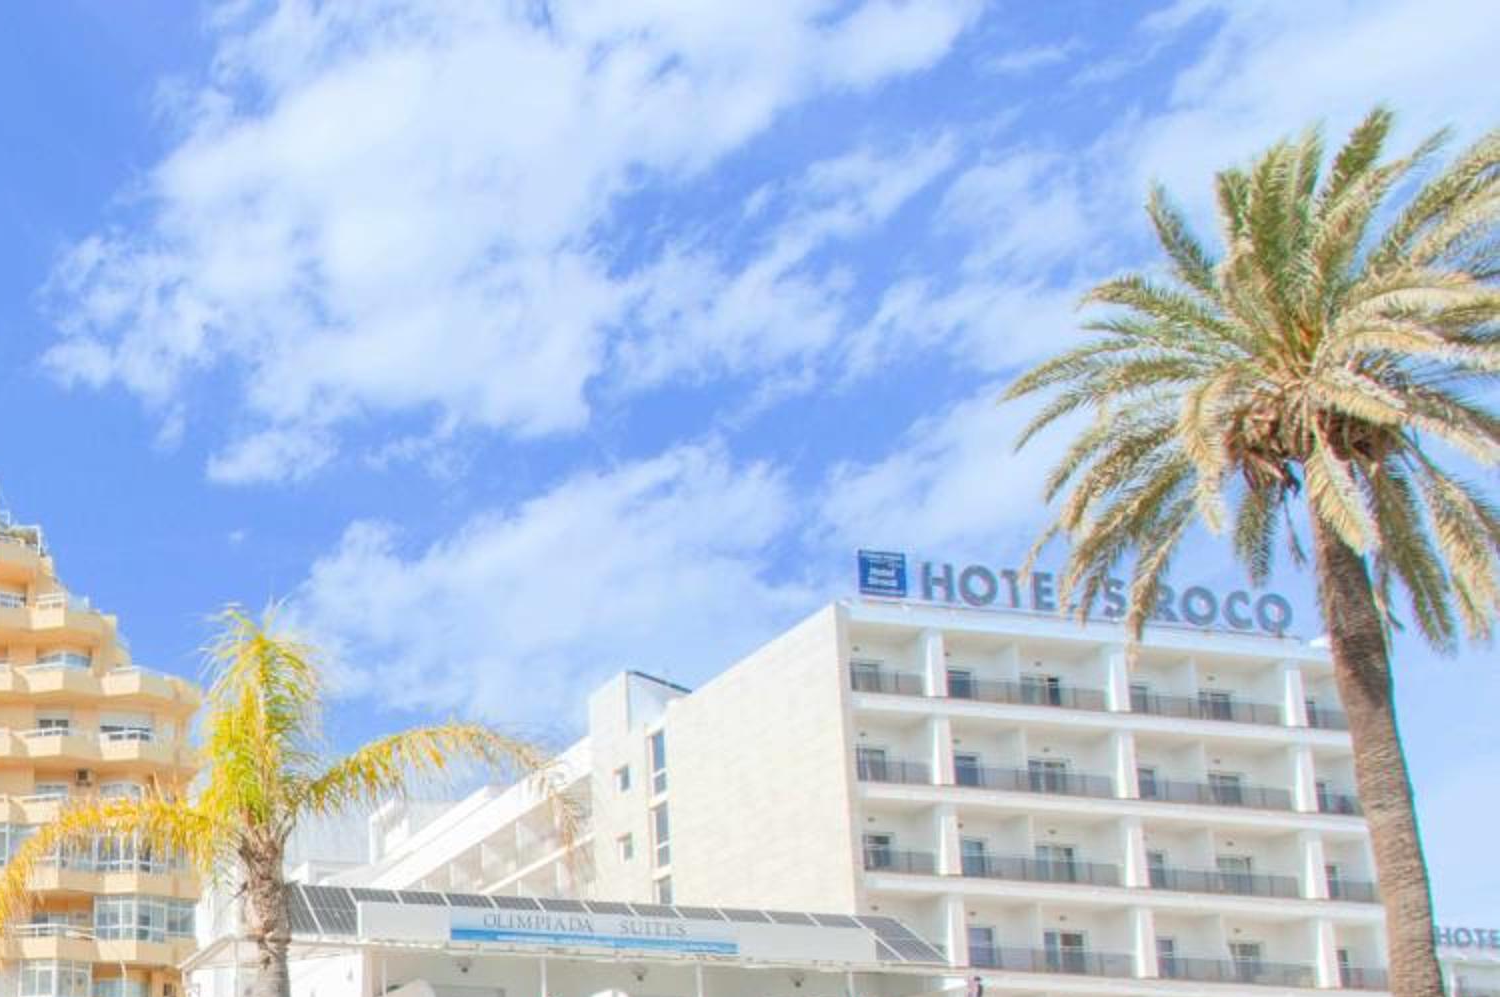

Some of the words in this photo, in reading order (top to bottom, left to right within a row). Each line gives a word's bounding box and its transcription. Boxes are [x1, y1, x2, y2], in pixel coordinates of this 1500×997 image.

[920, 561, 1078, 614] HOTE
[1102, 577, 1293, 634] SROCO
[482, 911, 595, 933] OLIMPIADA
[618, 921, 689, 938] SUITES
